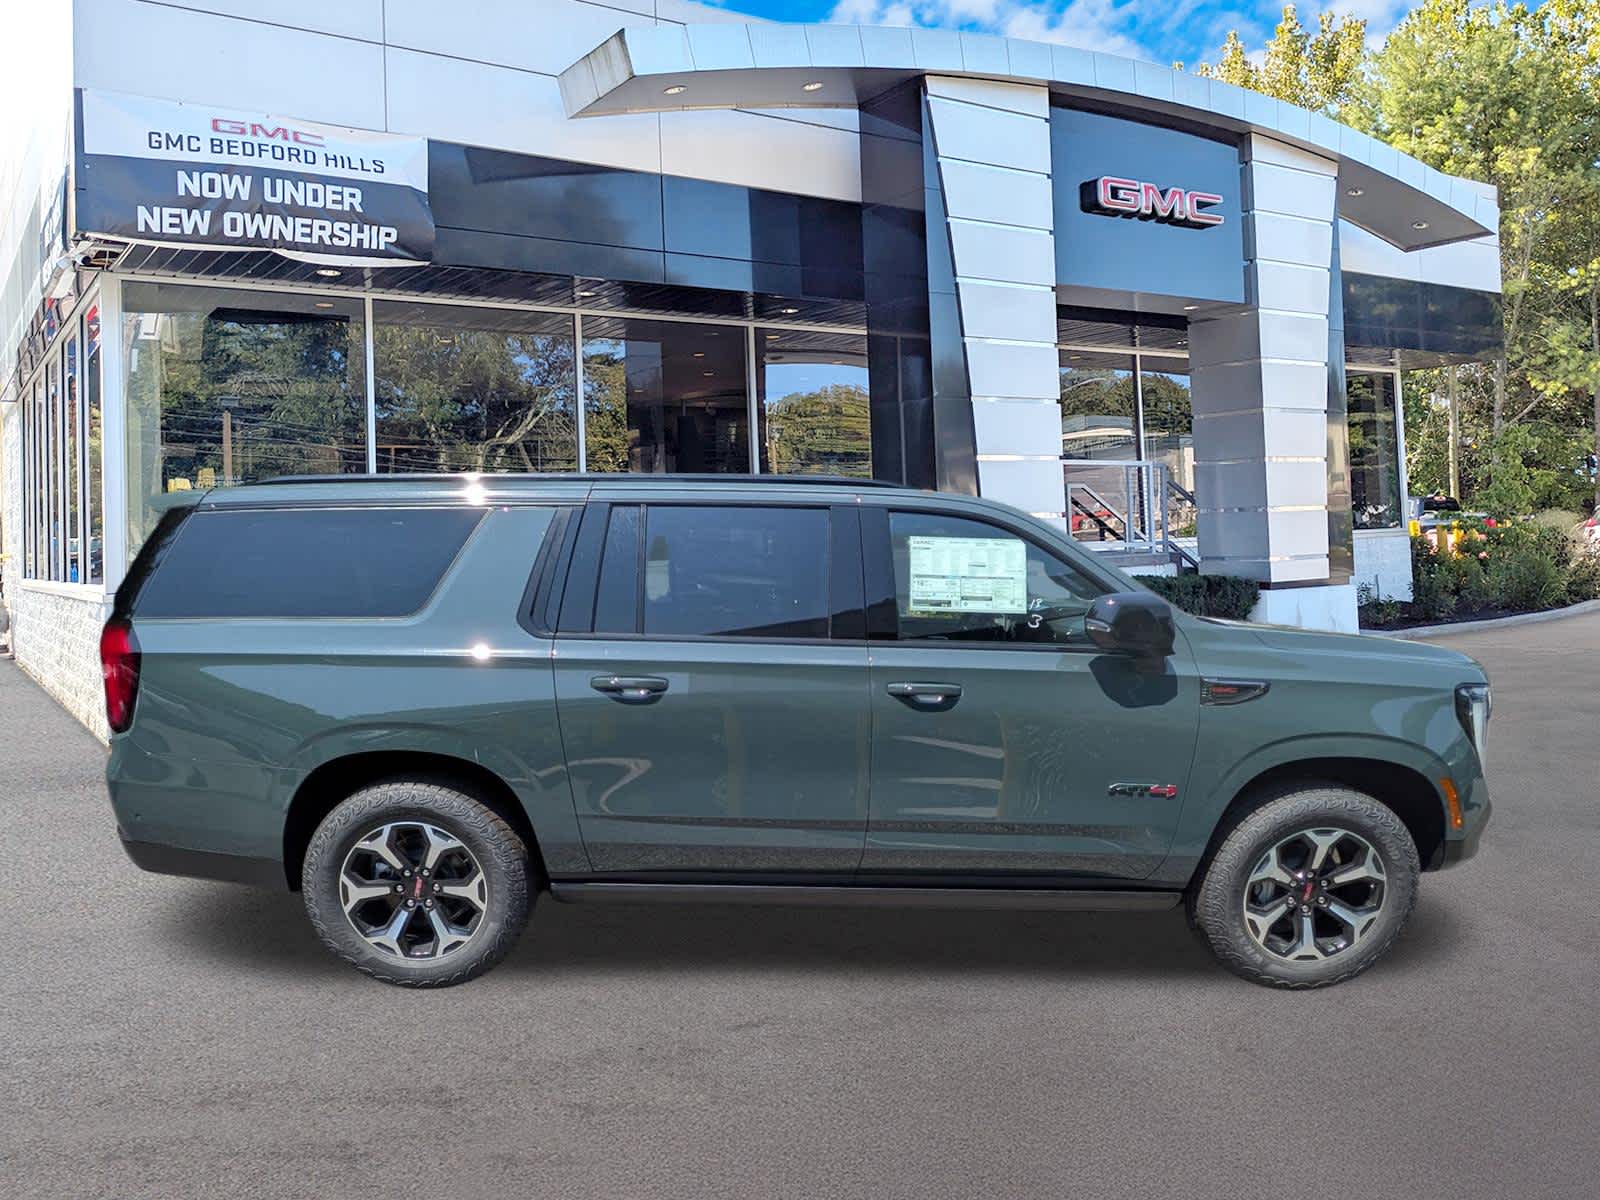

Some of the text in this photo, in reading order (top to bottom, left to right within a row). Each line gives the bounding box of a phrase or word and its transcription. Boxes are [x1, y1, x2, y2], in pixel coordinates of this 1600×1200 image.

[147, 131, 385, 174] GMC BEDFORD HILLS
[211, 118, 325, 148] GMC
[176, 169, 363, 213] NOW UNDER
[1098, 175, 1225, 225] GMC
[136, 205, 398, 251] NEW OWNERSHIP
